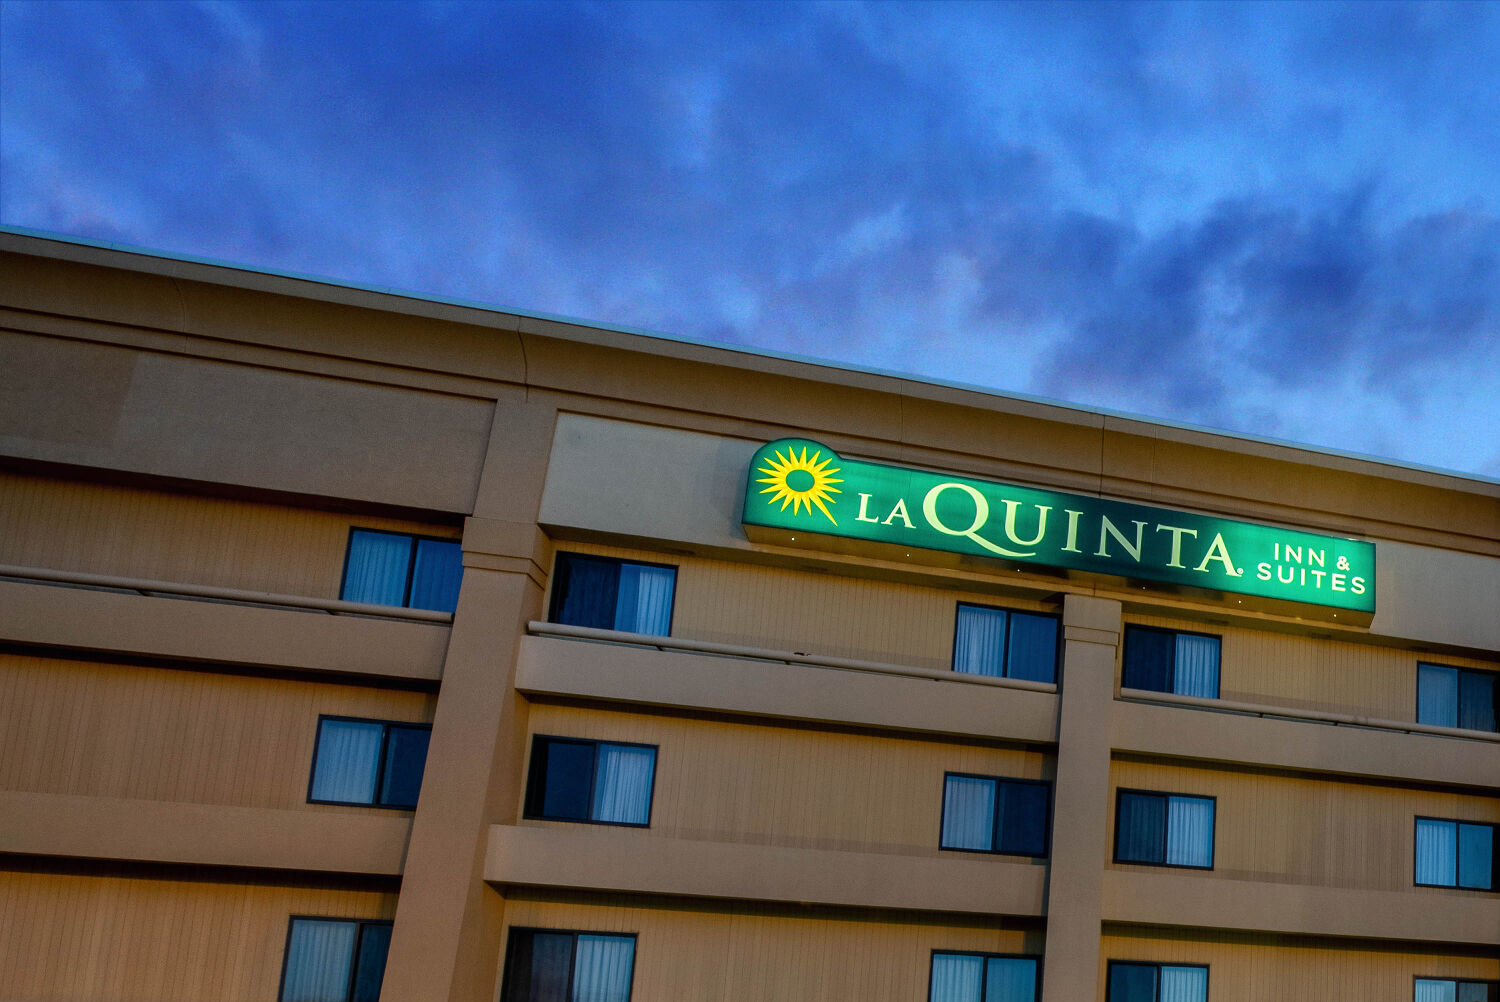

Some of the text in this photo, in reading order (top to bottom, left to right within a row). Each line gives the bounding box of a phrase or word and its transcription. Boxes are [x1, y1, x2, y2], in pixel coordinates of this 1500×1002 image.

[855, 492, 916, 529] LA
[1274, 542, 1351, 572] INN &
[1256, 562, 1366, 595] SUITES
